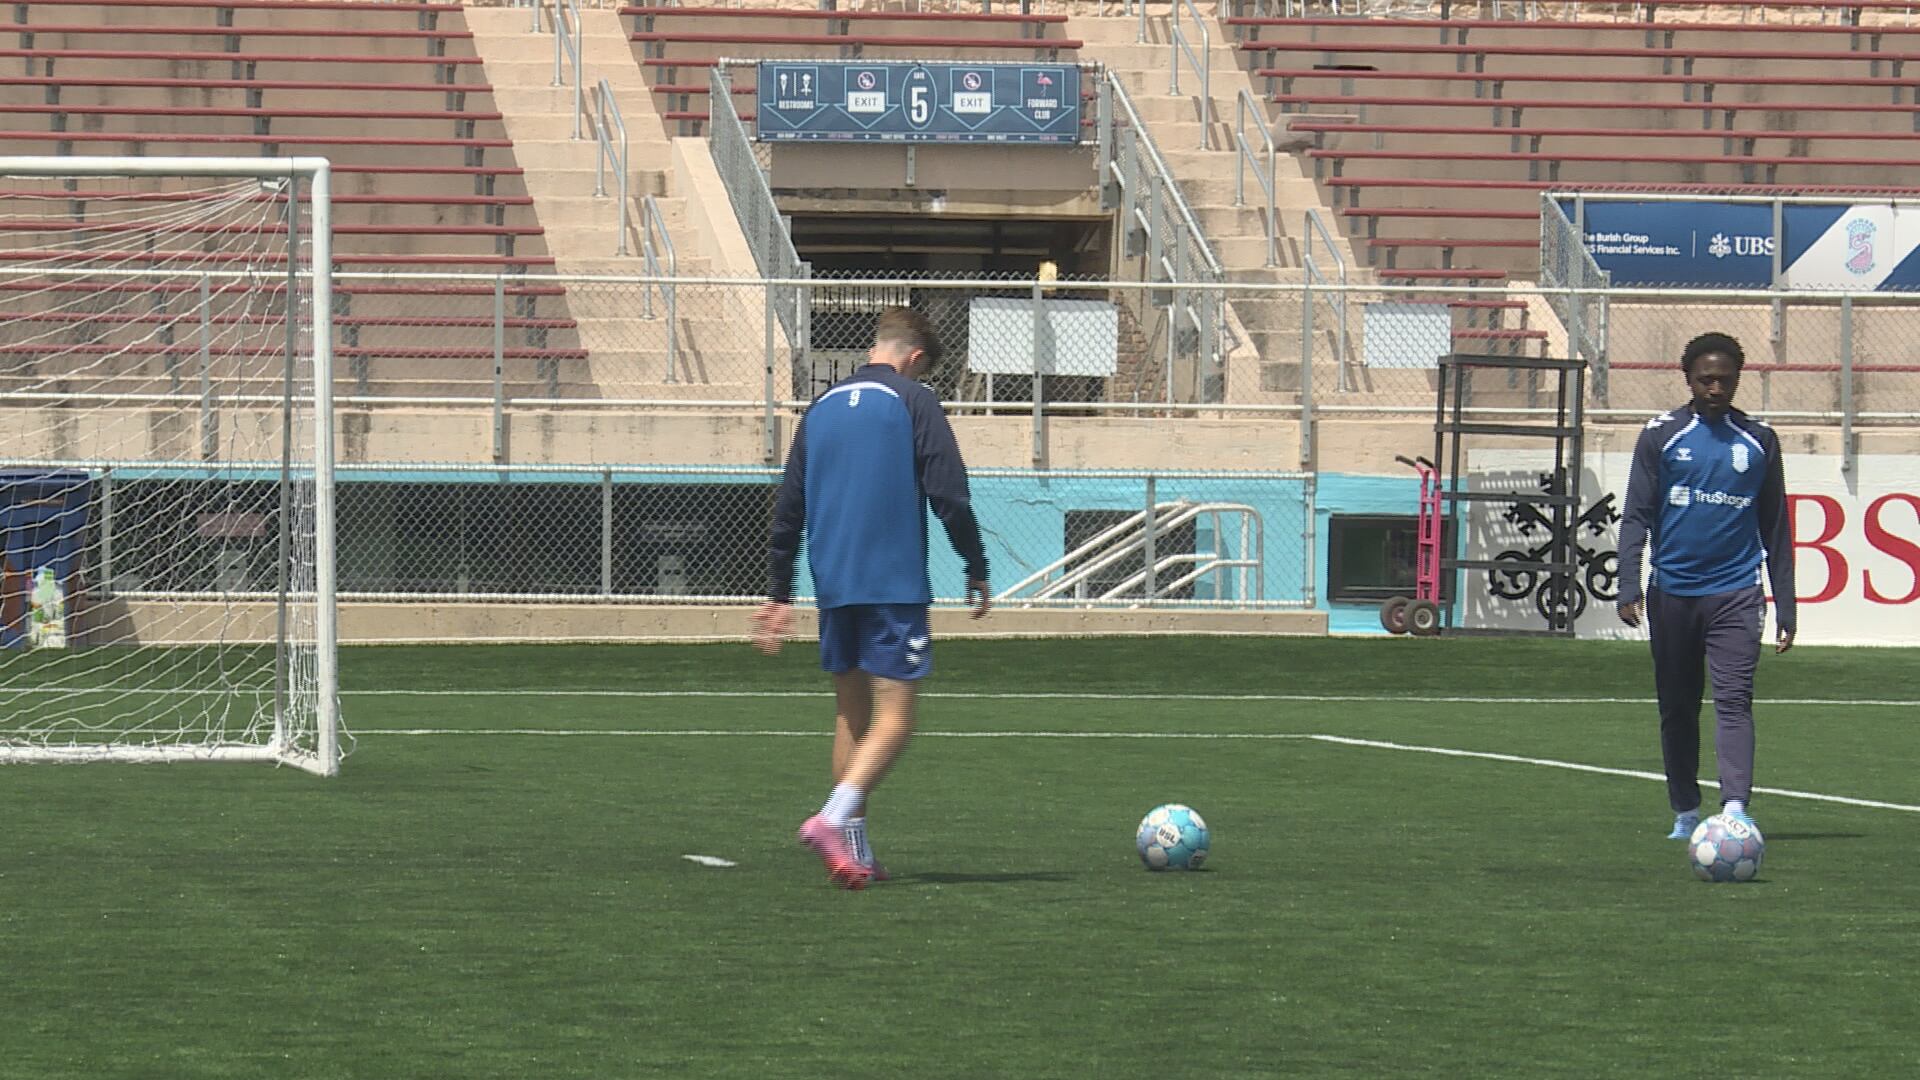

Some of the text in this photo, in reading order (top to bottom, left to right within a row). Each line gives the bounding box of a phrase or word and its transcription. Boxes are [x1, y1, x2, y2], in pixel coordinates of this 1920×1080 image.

[778, 100, 814, 109] RESTROOMS
[854, 97, 878, 107] EXIT
[911, 87, 928, 123] 5
[960, 97, 984, 107] EXIT
[1027, 98, 1058, 109] FORWARD
[1034, 110, 1050, 120] CLUB
[1596, 232, 1622, 242] Burish
[1623, 233, 1649, 244] Group
[1597, 244, 1632, 254] Financial
[1633, 245, 1665, 255] Services
[1666, 246, 1681, 256] Inc.
[1734, 236, 1776, 256] UBS
[1694, 489, 1752, 509] TruStage
[1765, 492, 1920, 605] BS
